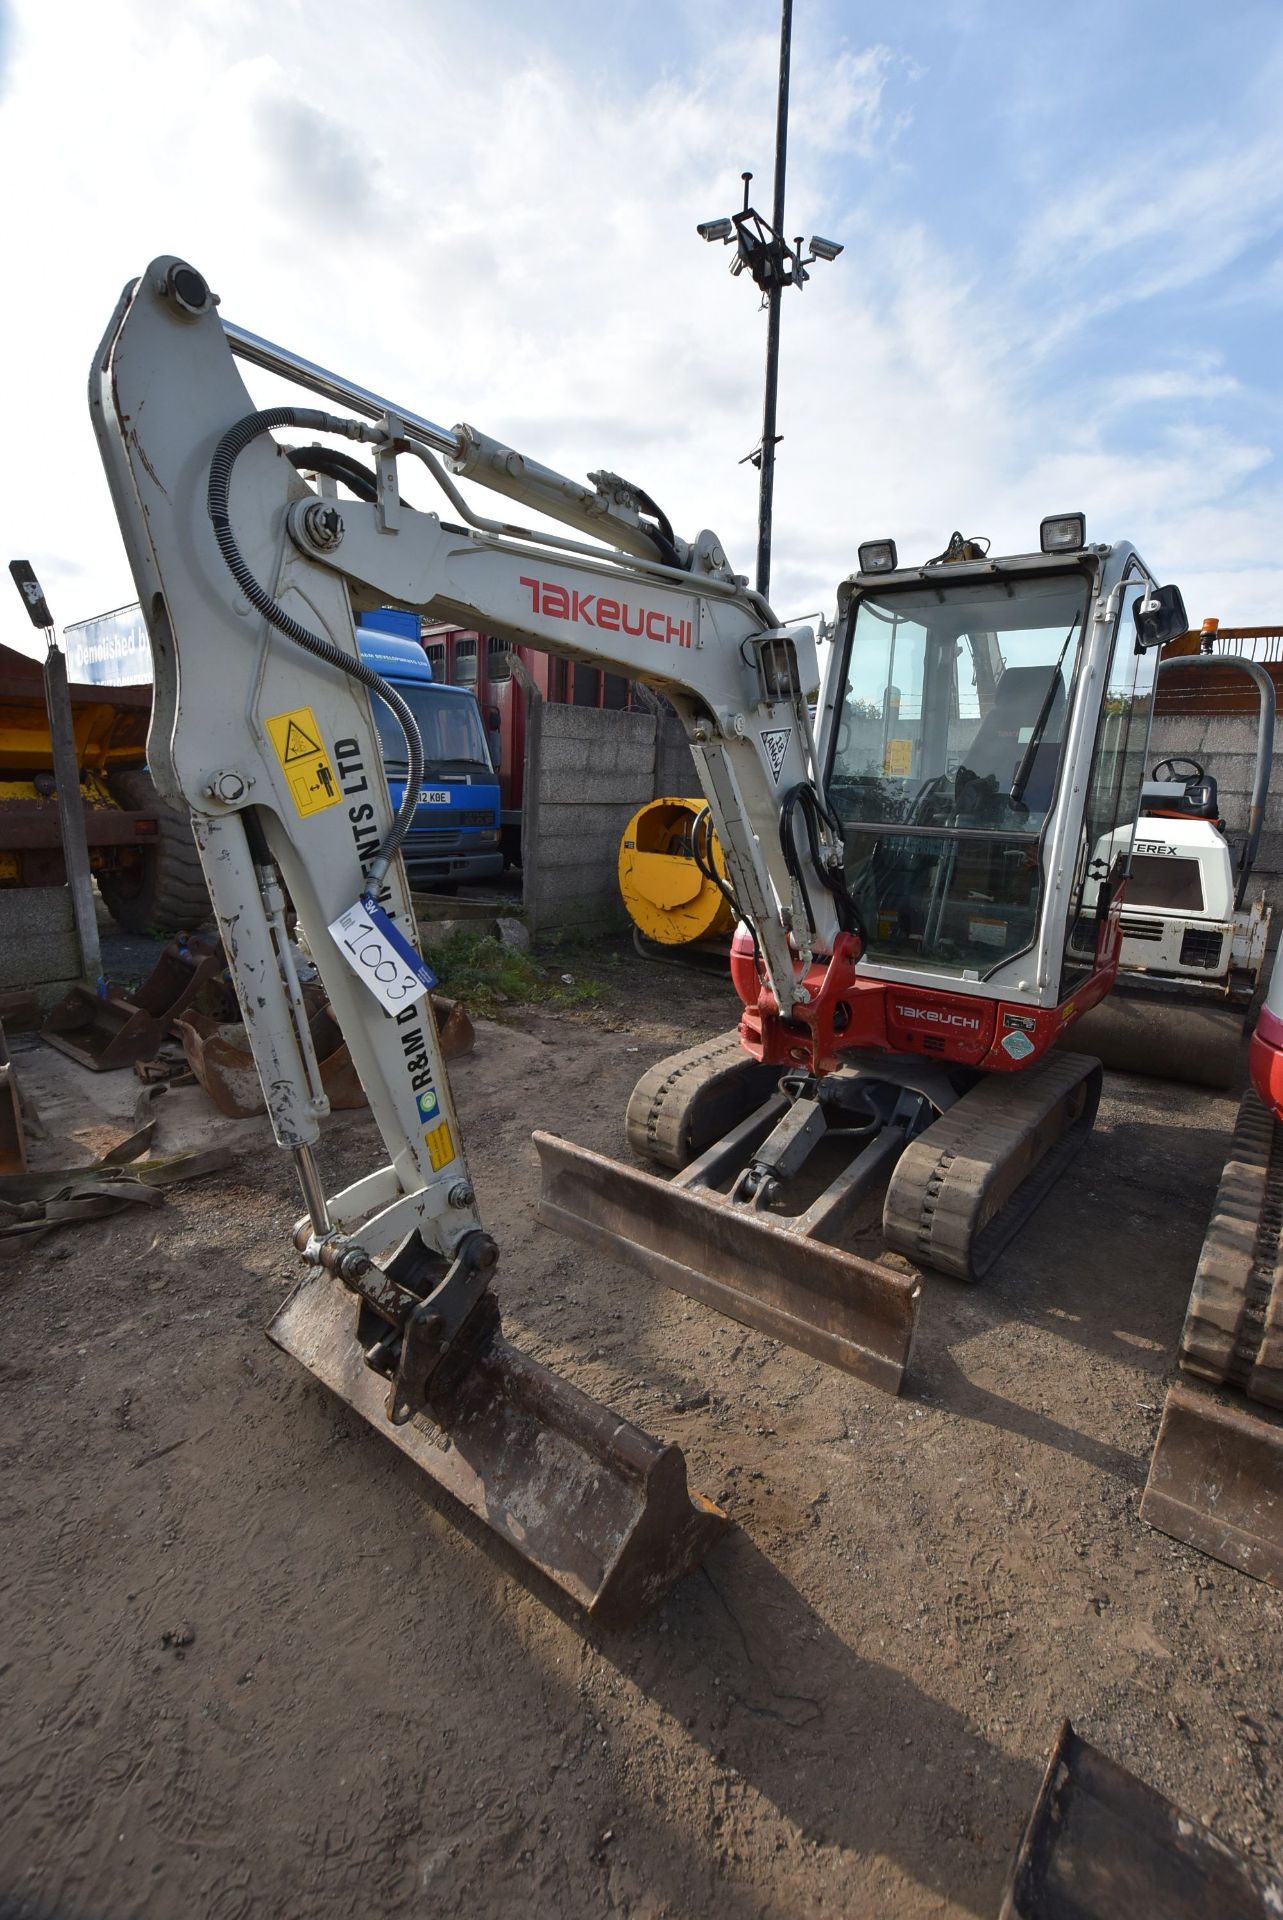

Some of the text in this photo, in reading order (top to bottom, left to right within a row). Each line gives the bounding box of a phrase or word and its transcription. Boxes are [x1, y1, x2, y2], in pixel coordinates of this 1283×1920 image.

[77, 628, 135, 665] Demolished
[334, 738, 368, 795] LTD
[1133, 843, 1178, 855] EREX
[344, 923, 417, 999] 1003
[401, 1027, 433, 1092] R&M
